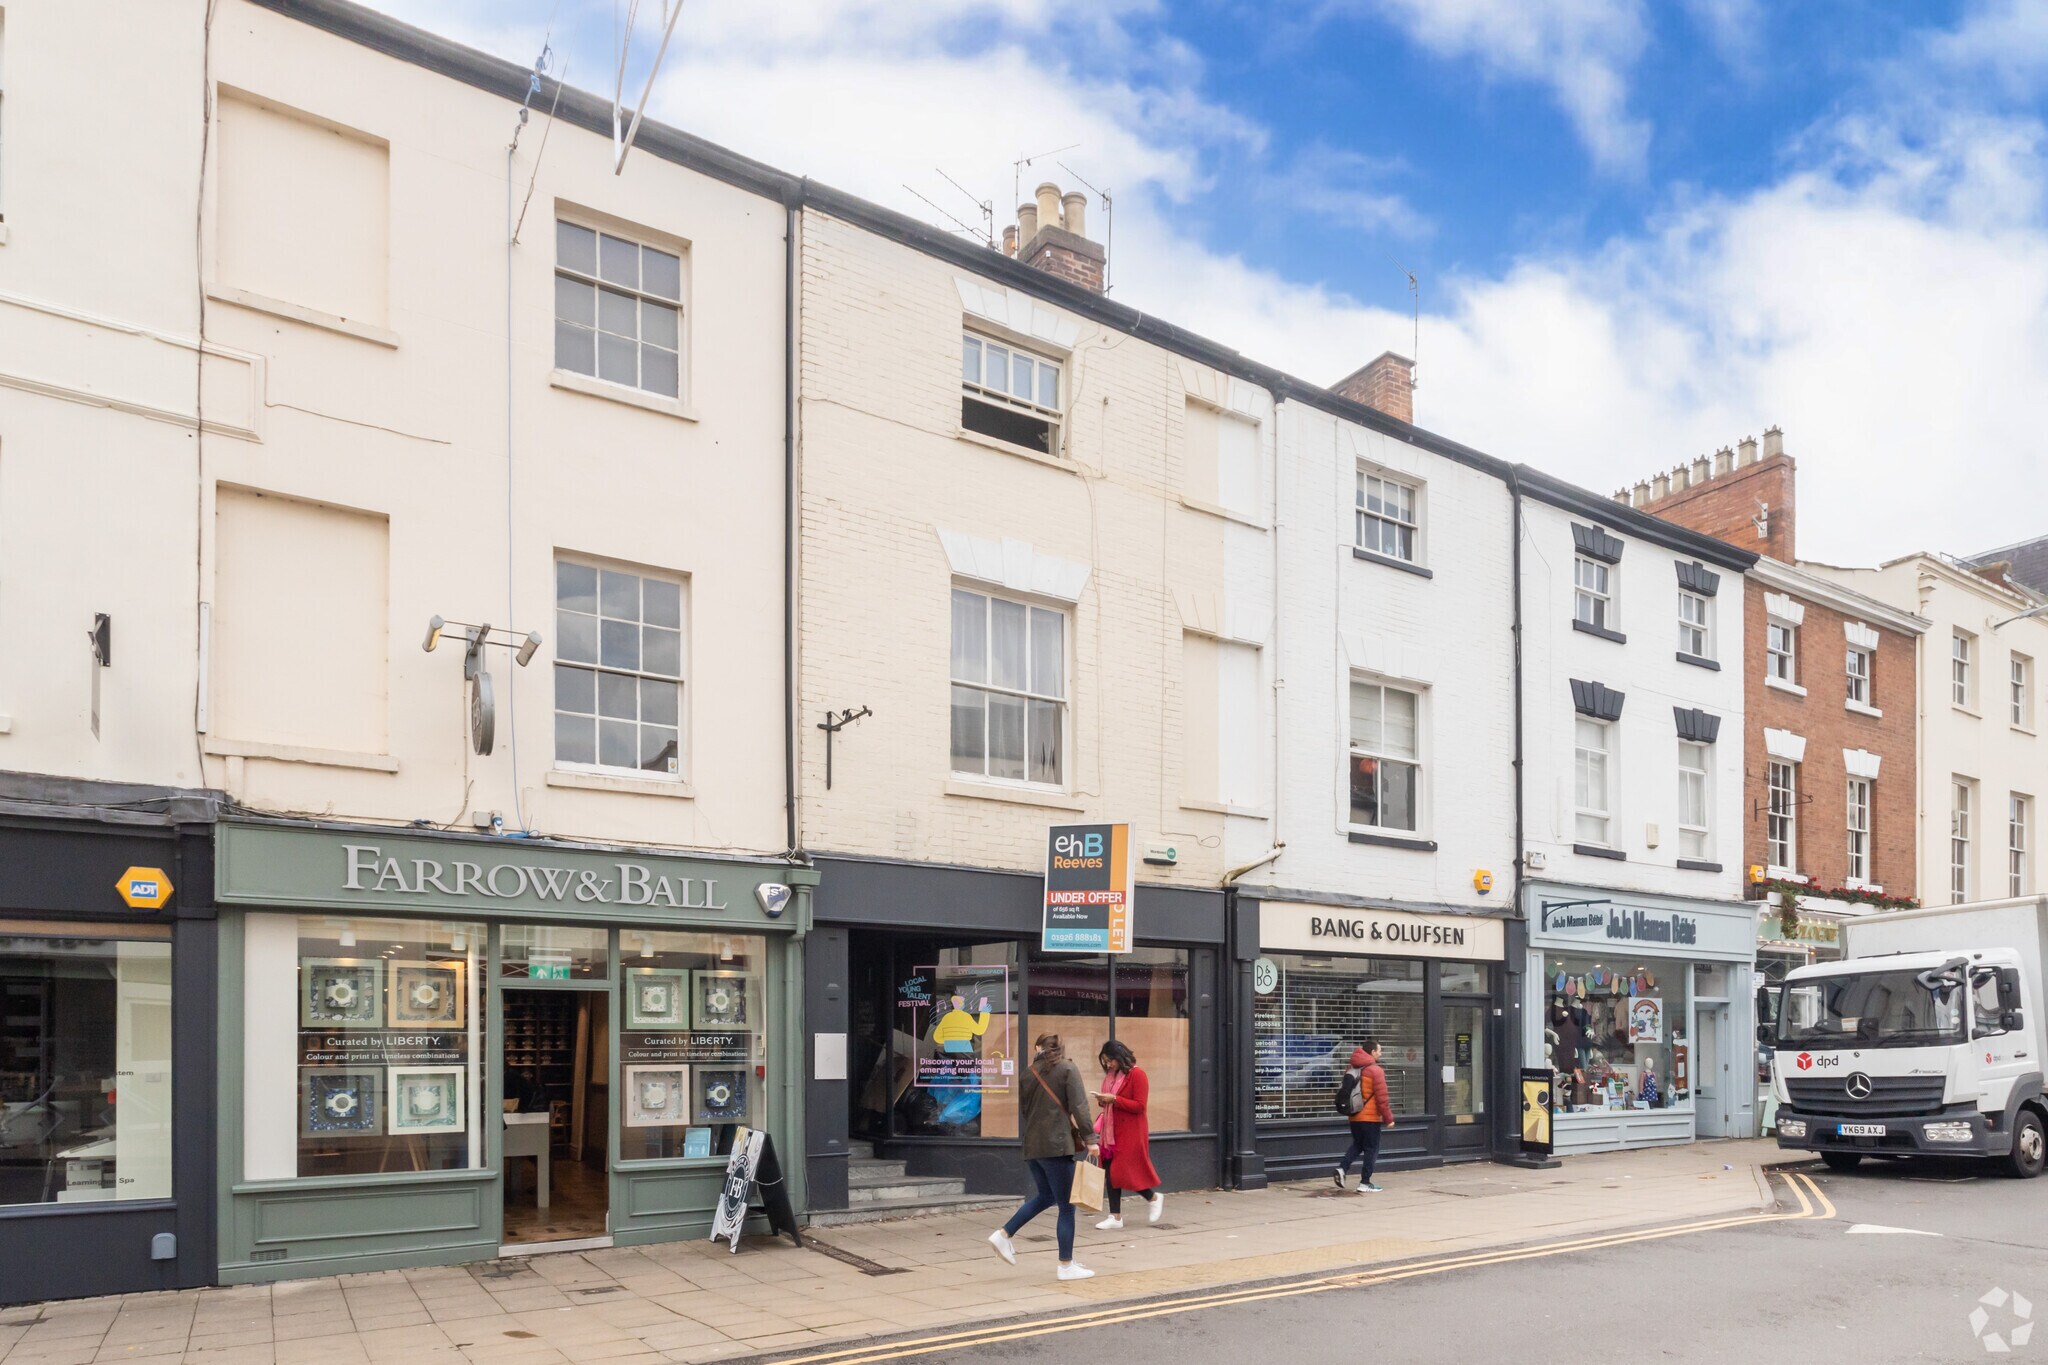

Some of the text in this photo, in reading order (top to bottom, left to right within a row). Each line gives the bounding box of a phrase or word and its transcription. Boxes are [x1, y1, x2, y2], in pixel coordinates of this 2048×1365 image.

[1055, 833, 1104, 857] ehB
[1054, 856, 1103, 869] Reeves
[131, 884, 157, 895] ADT
[1051, 892, 1122, 904] UNDER OFFER
[1552, 914, 1603, 928] JoJo Maman Bébé
[1311, 917, 1464, 945] BANG & OLUFSEN
[1607, 908, 1696, 945] JoJo Maman Bébé
[1051, 933, 1102, 942] 01926 888181
[1112, 918, 1124, 948] LET
[904, 976, 927, 986] LOCAL
[898, 985, 921, 993] YOUNG
[327, 1037, 368, 1046] Curated
[371, 1037, 383, 1047] by
[644, 1037, 676, 1045] Curated
[678, 1037, 688, 1046] by
[351, 1053, 370, 1061] print
[975, 1057, 995, 1065] local
[1817, 1055, 1839, 1068] dpd
[920, 1066, 998, 1075] emerging musicians
[1843, 1126, 1884, 1135] YK69 AXJ
